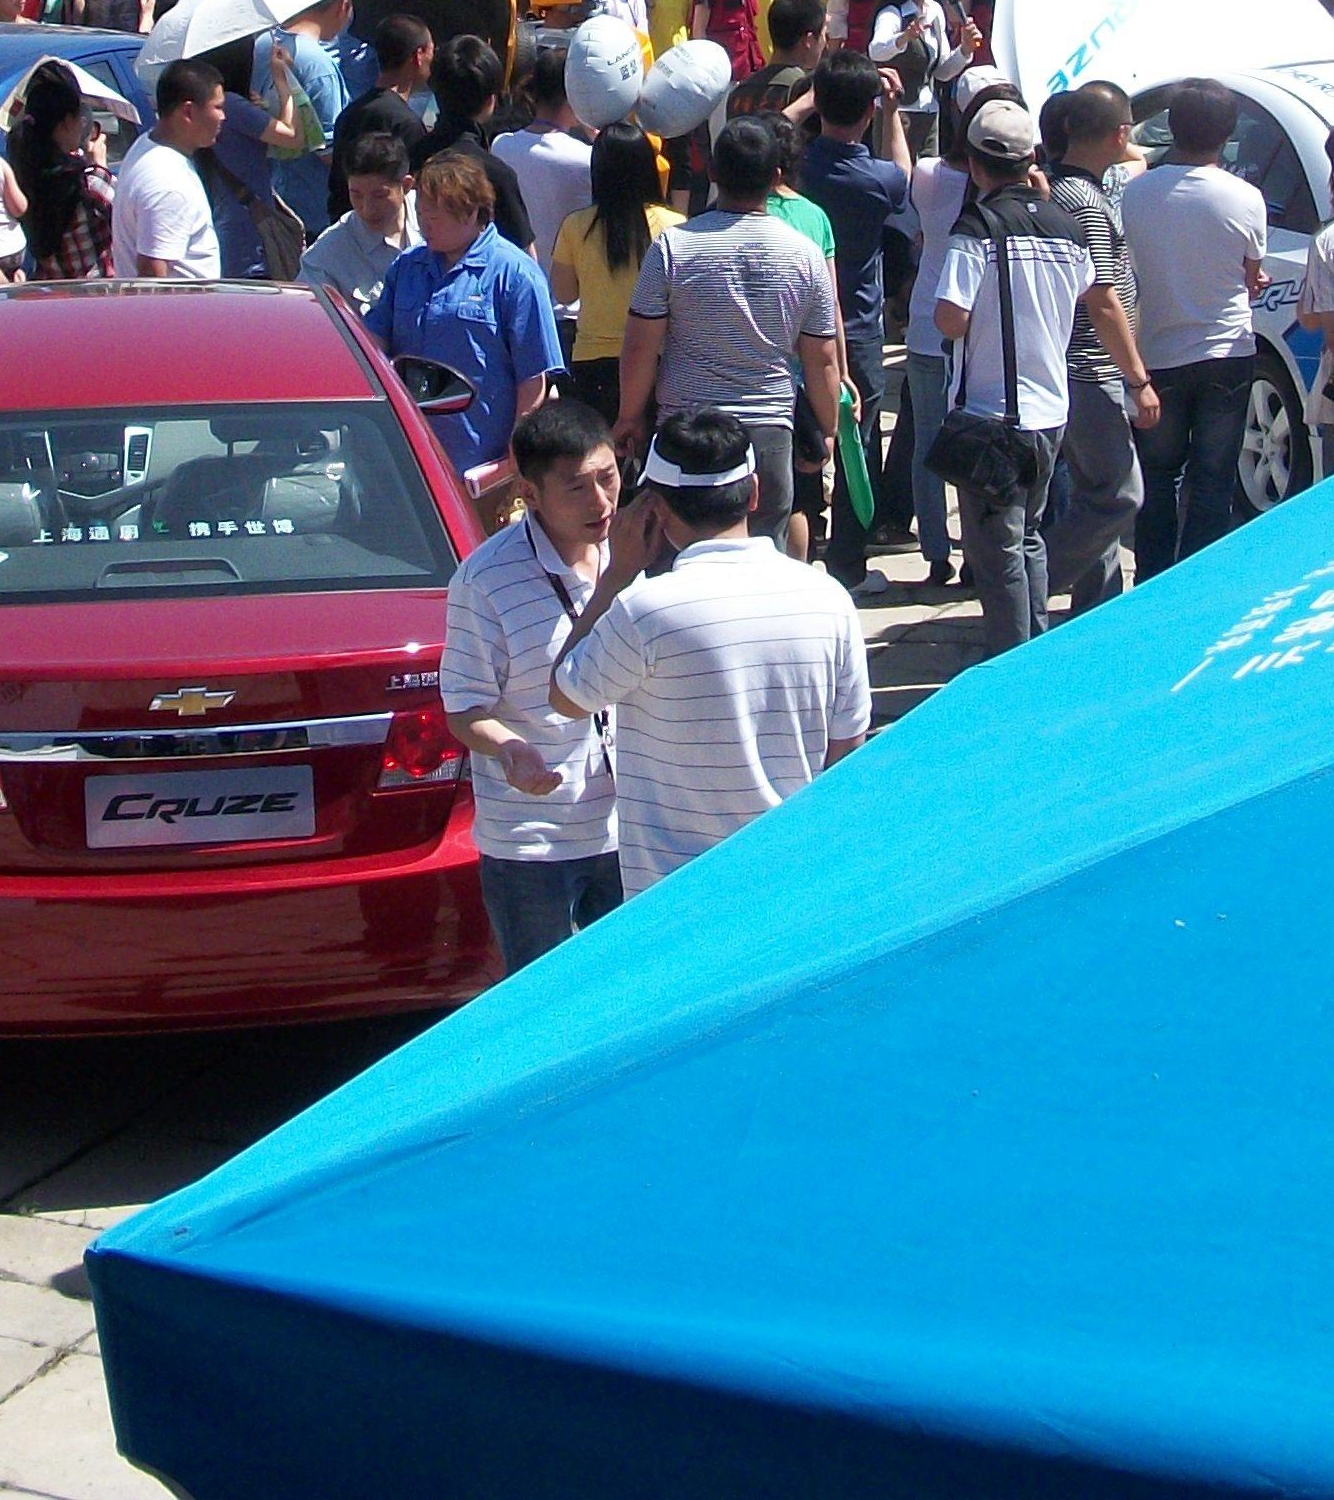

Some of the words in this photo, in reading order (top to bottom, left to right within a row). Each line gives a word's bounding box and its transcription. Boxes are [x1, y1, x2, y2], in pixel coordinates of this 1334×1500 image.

[188, 518, 295, 537] 携手世博
[101, 792, 299, 824] CRUZE
